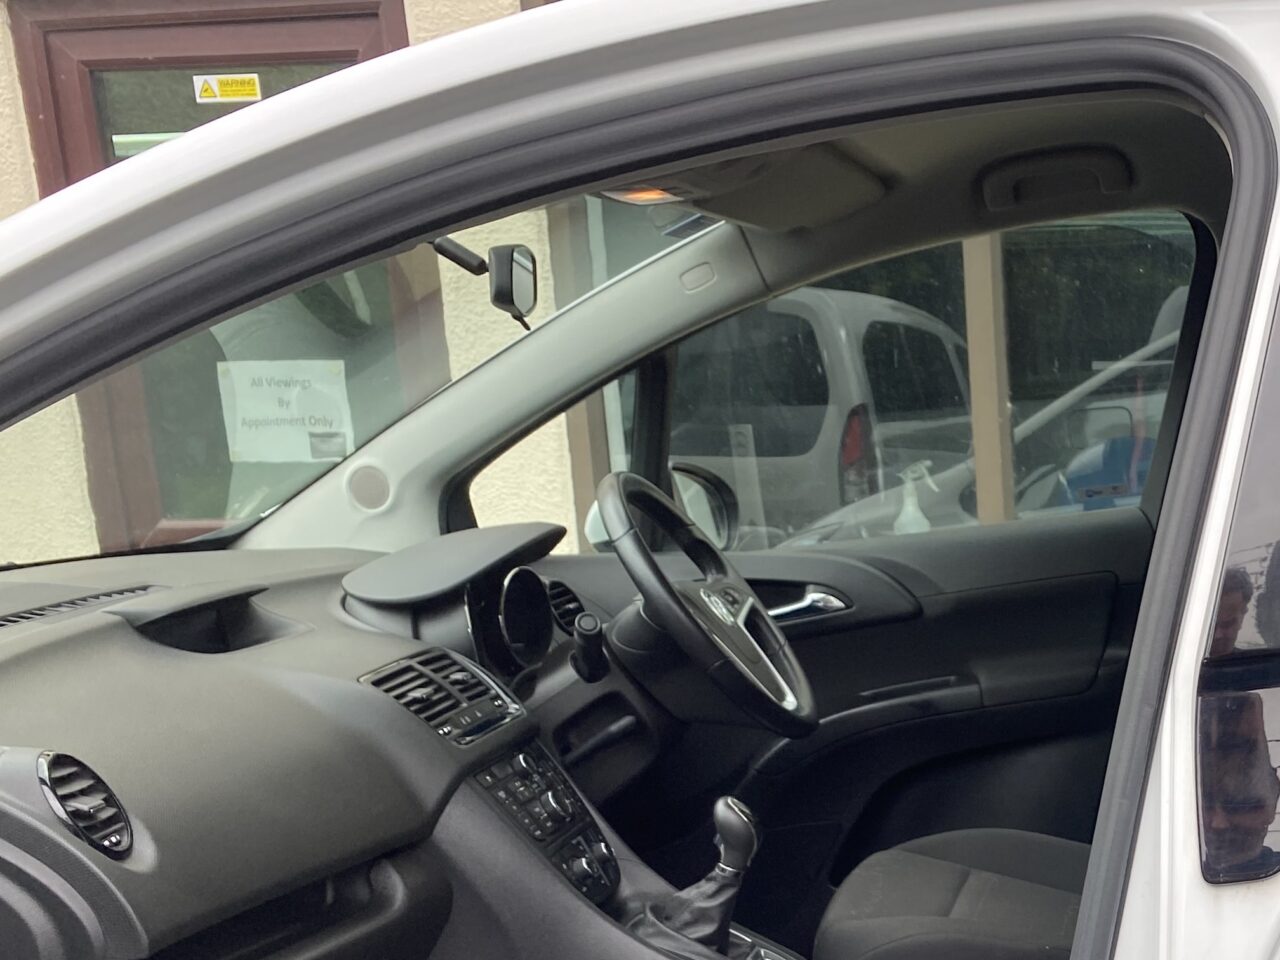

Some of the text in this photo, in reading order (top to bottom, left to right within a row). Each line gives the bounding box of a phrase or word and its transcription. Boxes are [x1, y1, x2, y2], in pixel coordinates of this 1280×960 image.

[250, 376, 312, 391] All Viewings
[277, 397, 290, 409] By
[241, 415, 333, 431] Appointment Only
